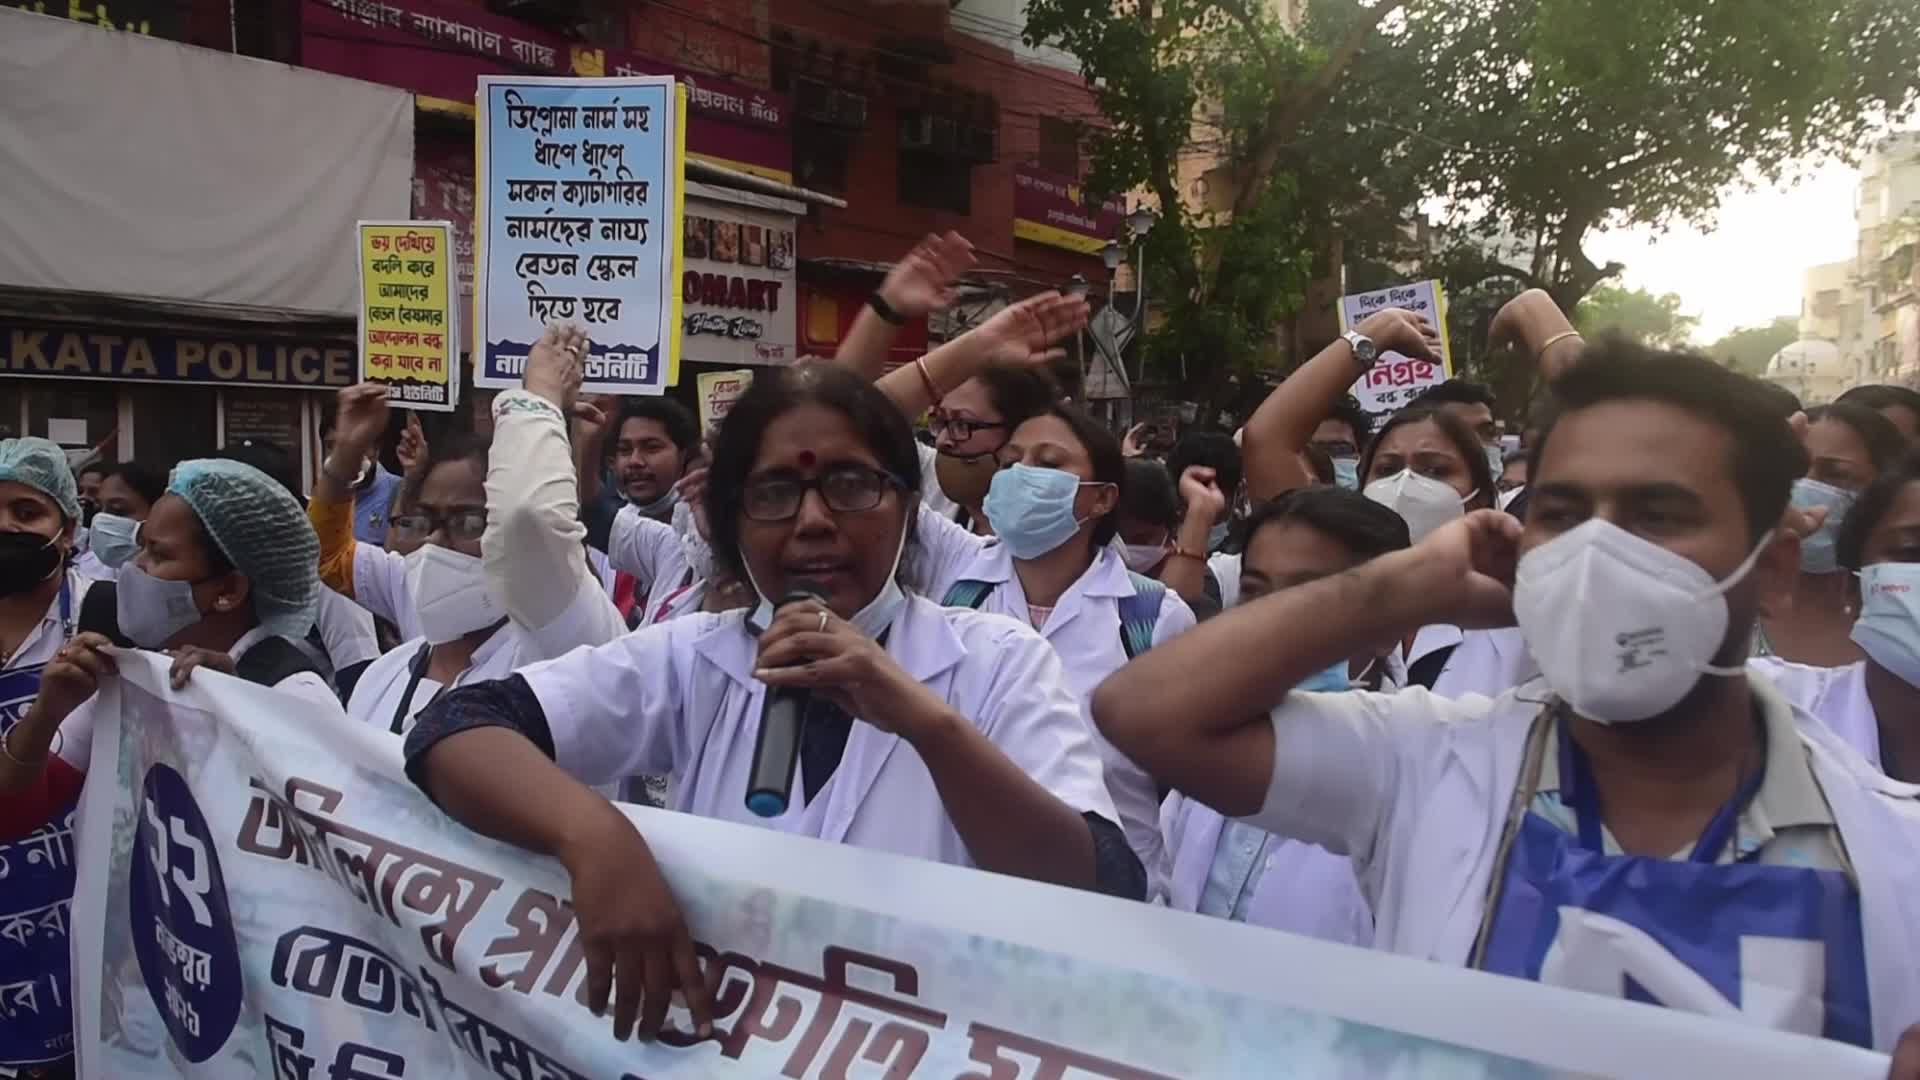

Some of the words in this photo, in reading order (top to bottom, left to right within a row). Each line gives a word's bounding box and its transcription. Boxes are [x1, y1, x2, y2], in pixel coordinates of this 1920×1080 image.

[505, 89, 578, 137] ডিপ্লোমা
[582, 96, 620, 130] নার্স
[622, 106, 650, 132] সহ
[534, 141, 578, 170] ধাপে
[583, 141, 626, 170] ধাপে
[506, 179, 557, 204] সকল
[505, 209, 594, 247] নার্সদের
[372, 255, 402, 275] বদলি
[407, 260, 434, 278] করে
[515, 254, 579, 280] বেতন
[586, 254, 638, 281] স্কেল
[379, 283, 429, 300] আমাদের
[527, 281, 578, 324] দিতে
[581, 297, 621, 324] হবে
[0, 328, 158, 376] KATA
[175, 340, 352, 385] POLICE
[397, 355, 423, 373] যাবে
[428, 357, 442, 373] না
[583, 352, 649, 380] উনিটি
[145, 797, 213, 927] ২২
